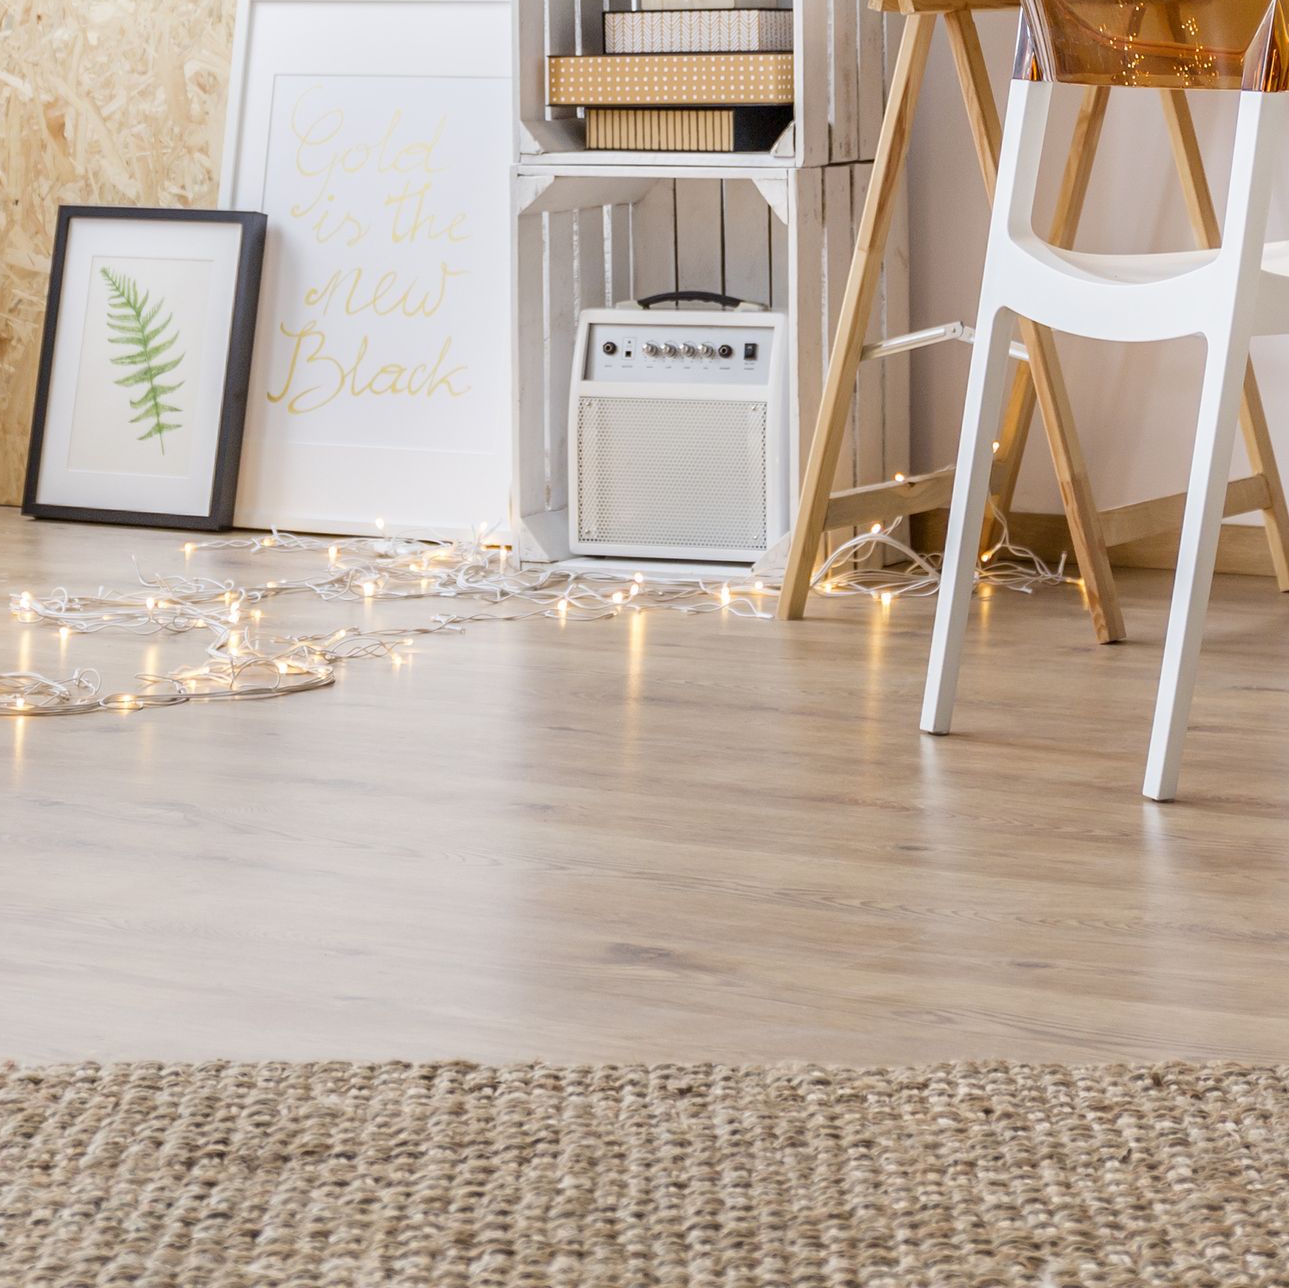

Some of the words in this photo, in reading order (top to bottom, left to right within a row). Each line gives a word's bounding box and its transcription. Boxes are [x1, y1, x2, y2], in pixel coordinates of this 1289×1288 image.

[290, 83, 452, 217] Gold
[313, 193, 373, 247] is
[383, 179, 473, 244] the
[304, 261, 472, 316] new
[266, 320, 472, 415] Black
